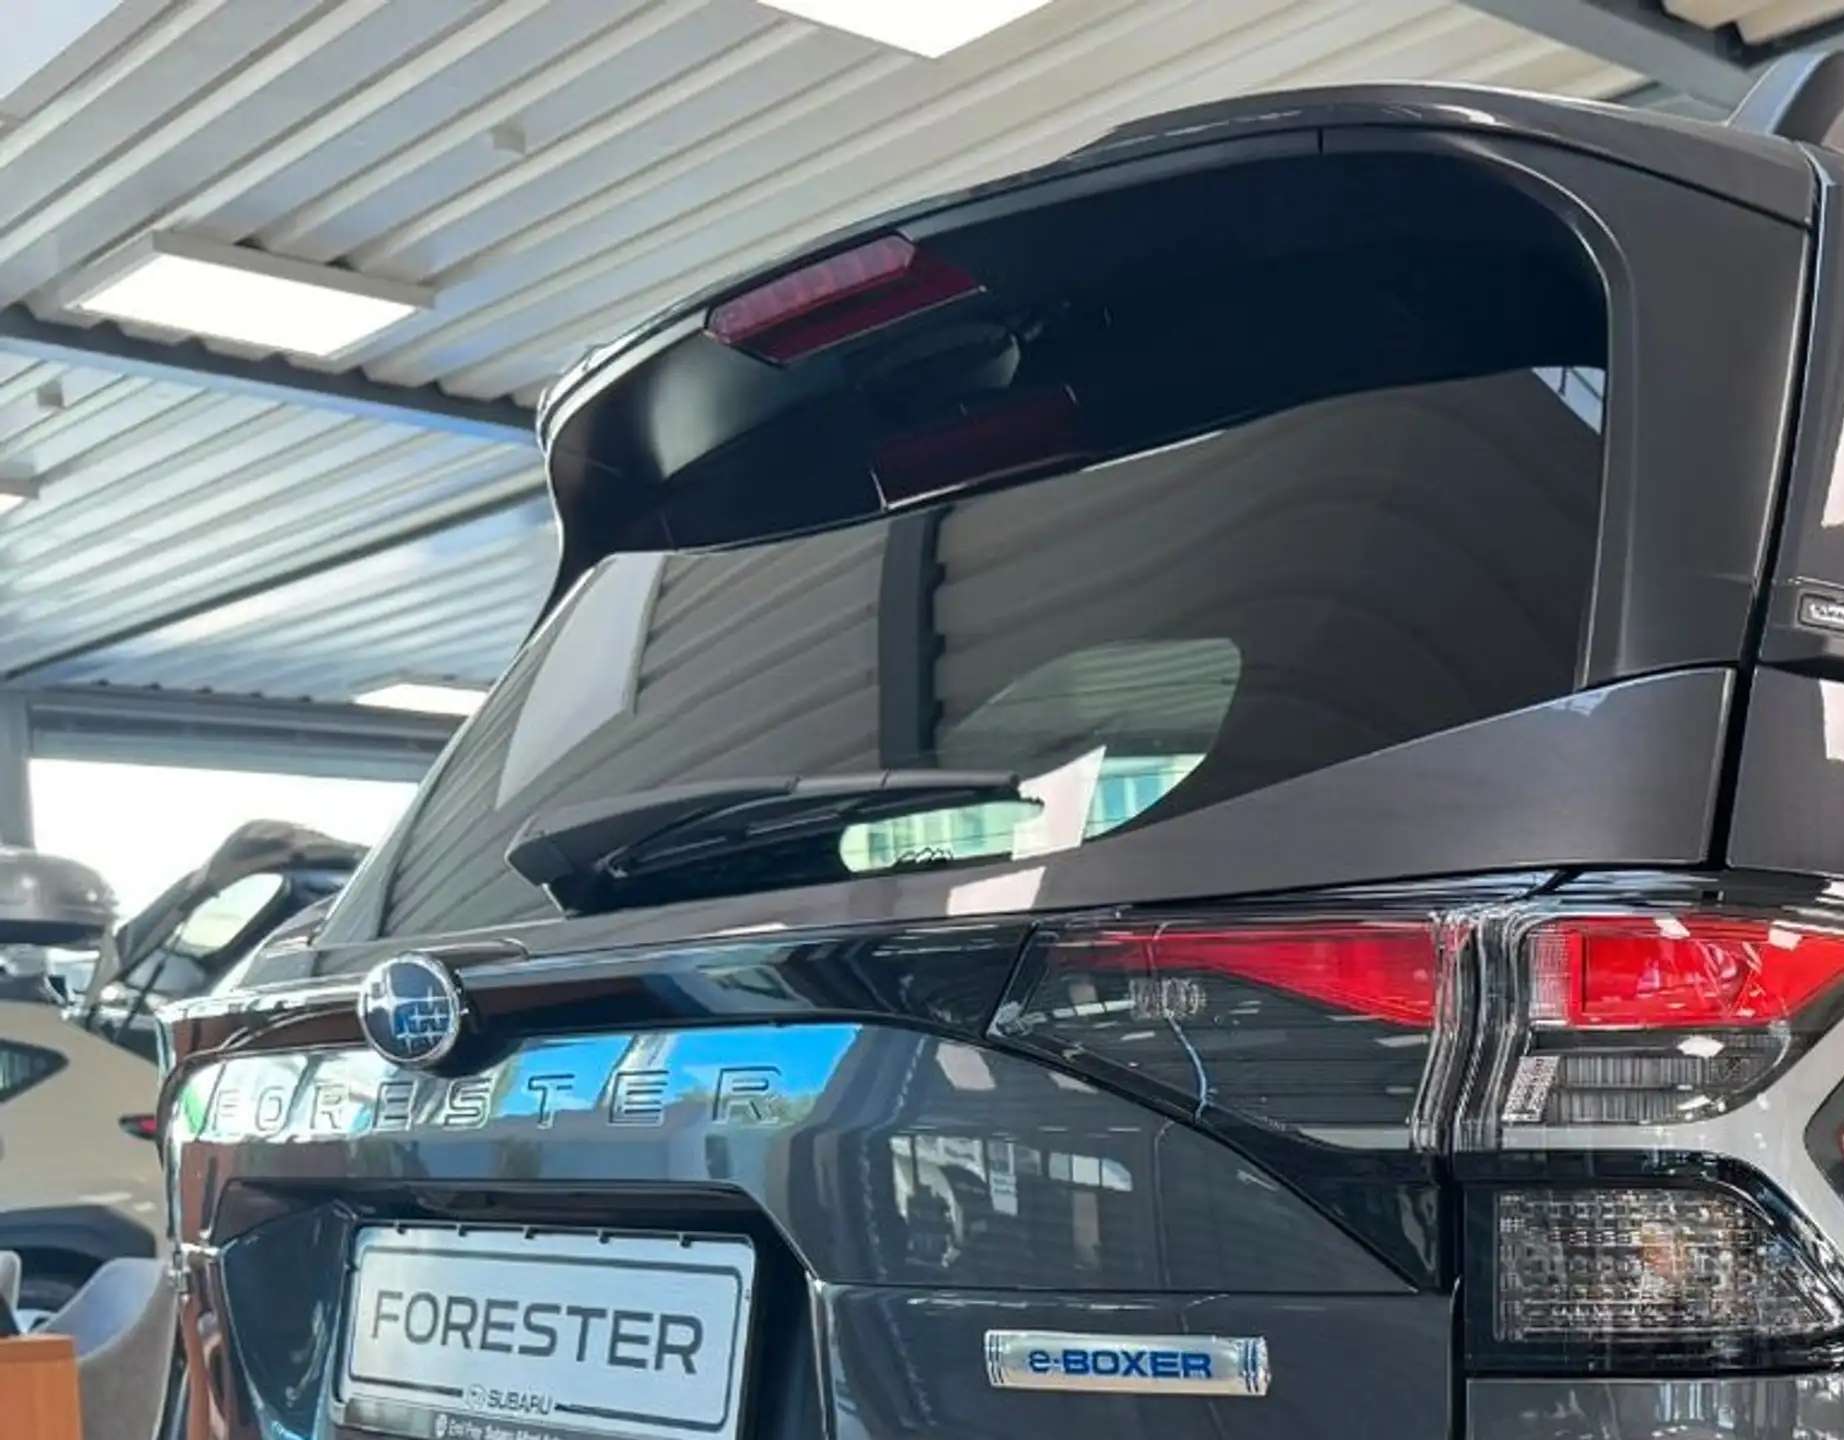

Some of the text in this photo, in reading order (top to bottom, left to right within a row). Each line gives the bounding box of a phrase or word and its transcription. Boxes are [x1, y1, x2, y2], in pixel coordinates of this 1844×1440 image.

[209, 1065, 784, 1131] FORESTER
[370, 1290, 705, 1374] FORESTER
[1028, 1350, 1213, 1379] e-BOXER
[487, 1389, 554, 1415] SUBARU
